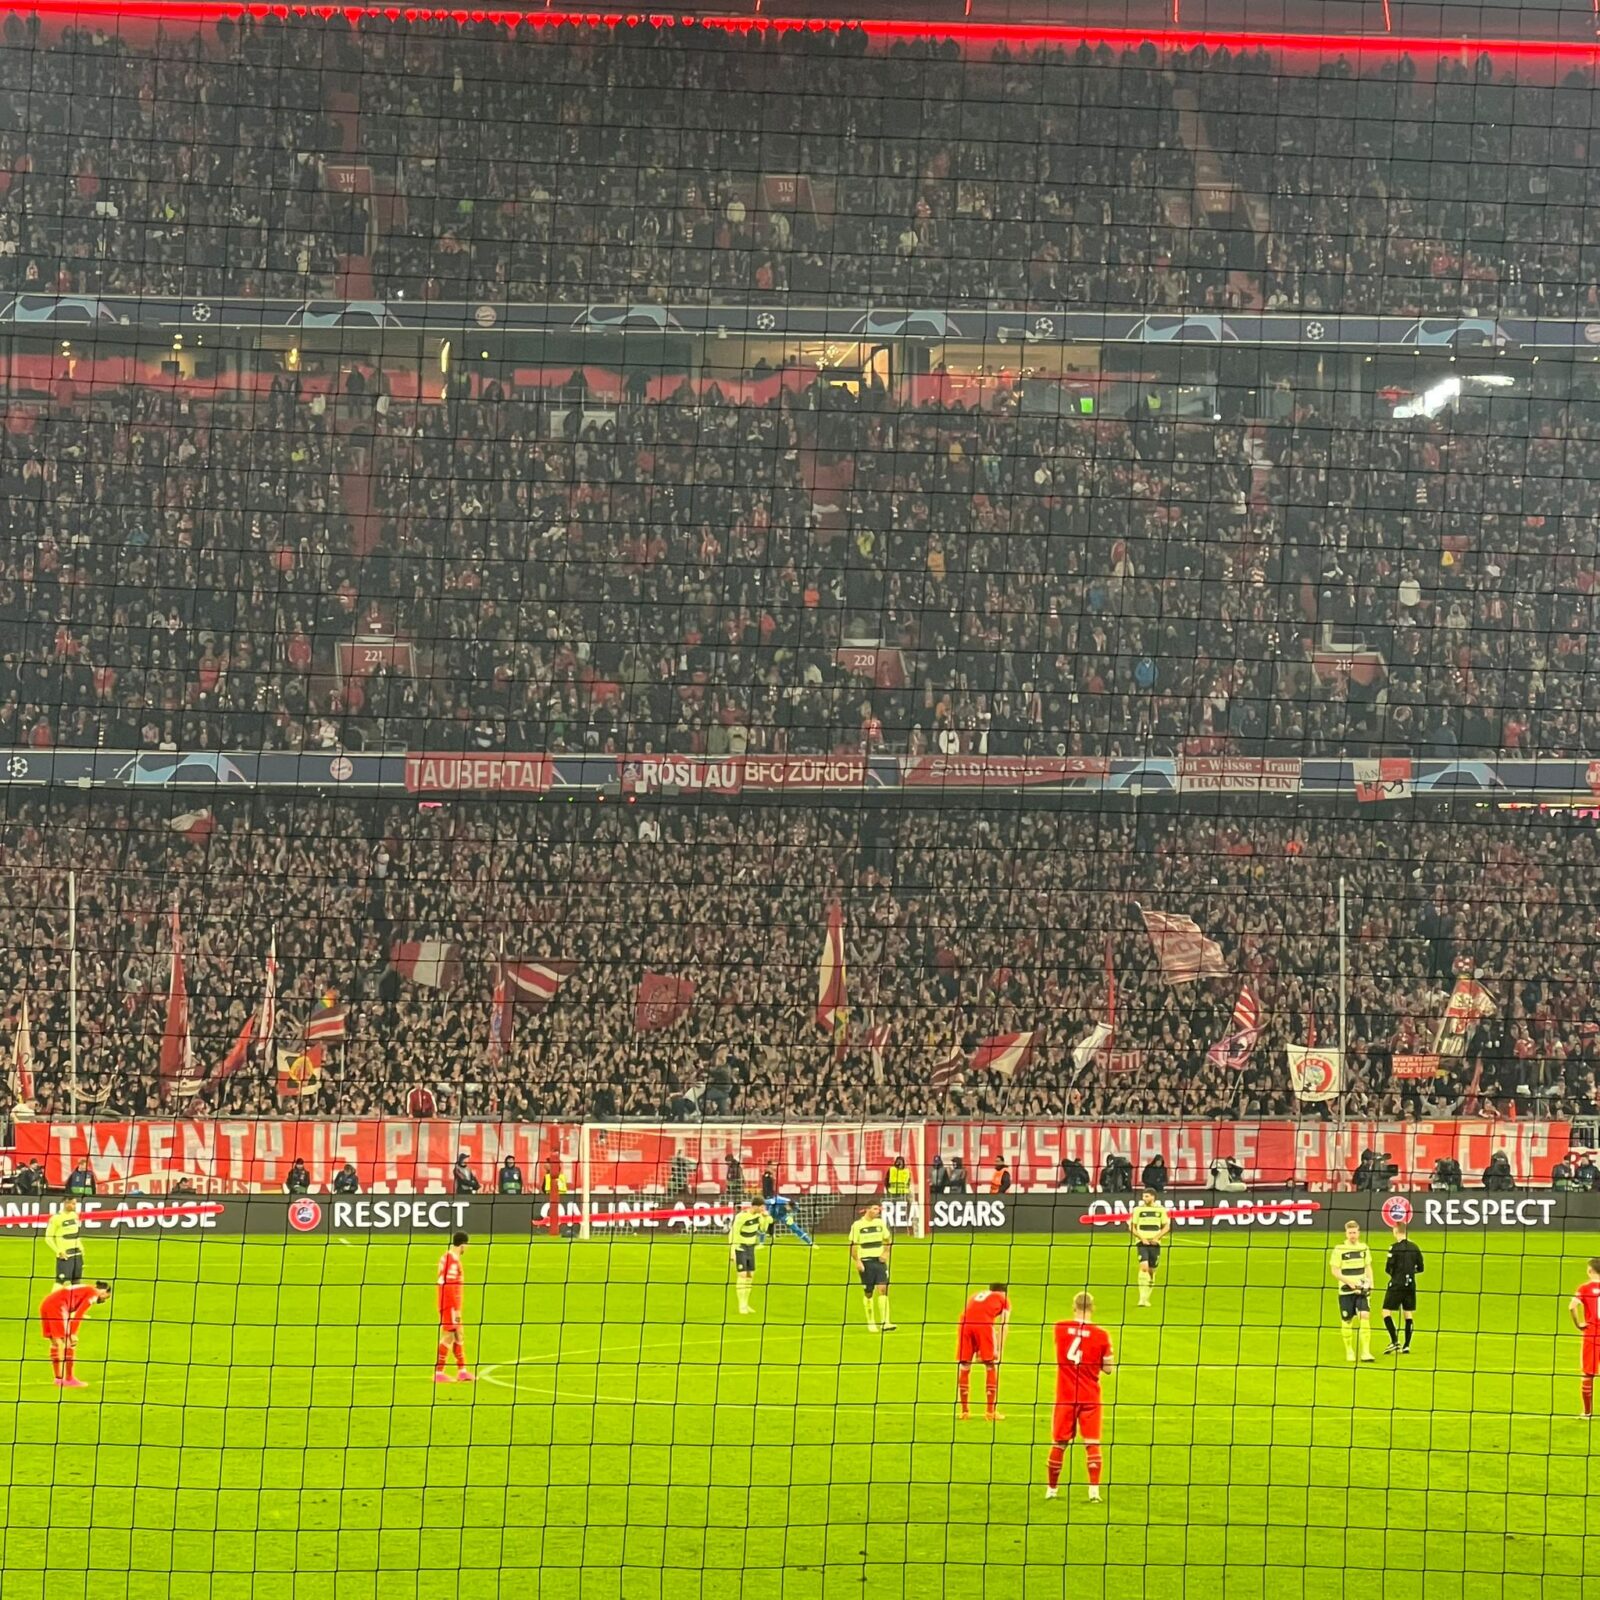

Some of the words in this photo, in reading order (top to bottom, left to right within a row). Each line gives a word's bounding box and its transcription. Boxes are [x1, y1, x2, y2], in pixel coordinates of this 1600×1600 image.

[777, 181, 794, 193] 315
[364, 650, 383, 662] 221
[853, 655, 875, 667] 220
[408, 758, 549, 790] TAUBERTAL
[642, 759, 738, 789] RÖSLAU
[744, 760, 783, 783] BFC
[787, 756, 864, 783] ZÜRICH
[1209, 759, 1252, 771] Weisse
[1188, 777, 1293, 789] TRAUNSTEIN
[50, 1122, 284, 1184] TWENTY
[385, 1122, 580, 1183] PLENTY
[0, 1202, 101, 1228] NLE
[110, 1202, 217, 1229] ABUSE
[334, 1201, 470, 1228] RESPECT
[1088, 1200, 1204, 1227] ONNE
[1212, 1200, 1313, 1226] ABUSE
[1424, 1199, 1557, 1226] RESPECT
[1066, 1336, 1084, 1366] 4
